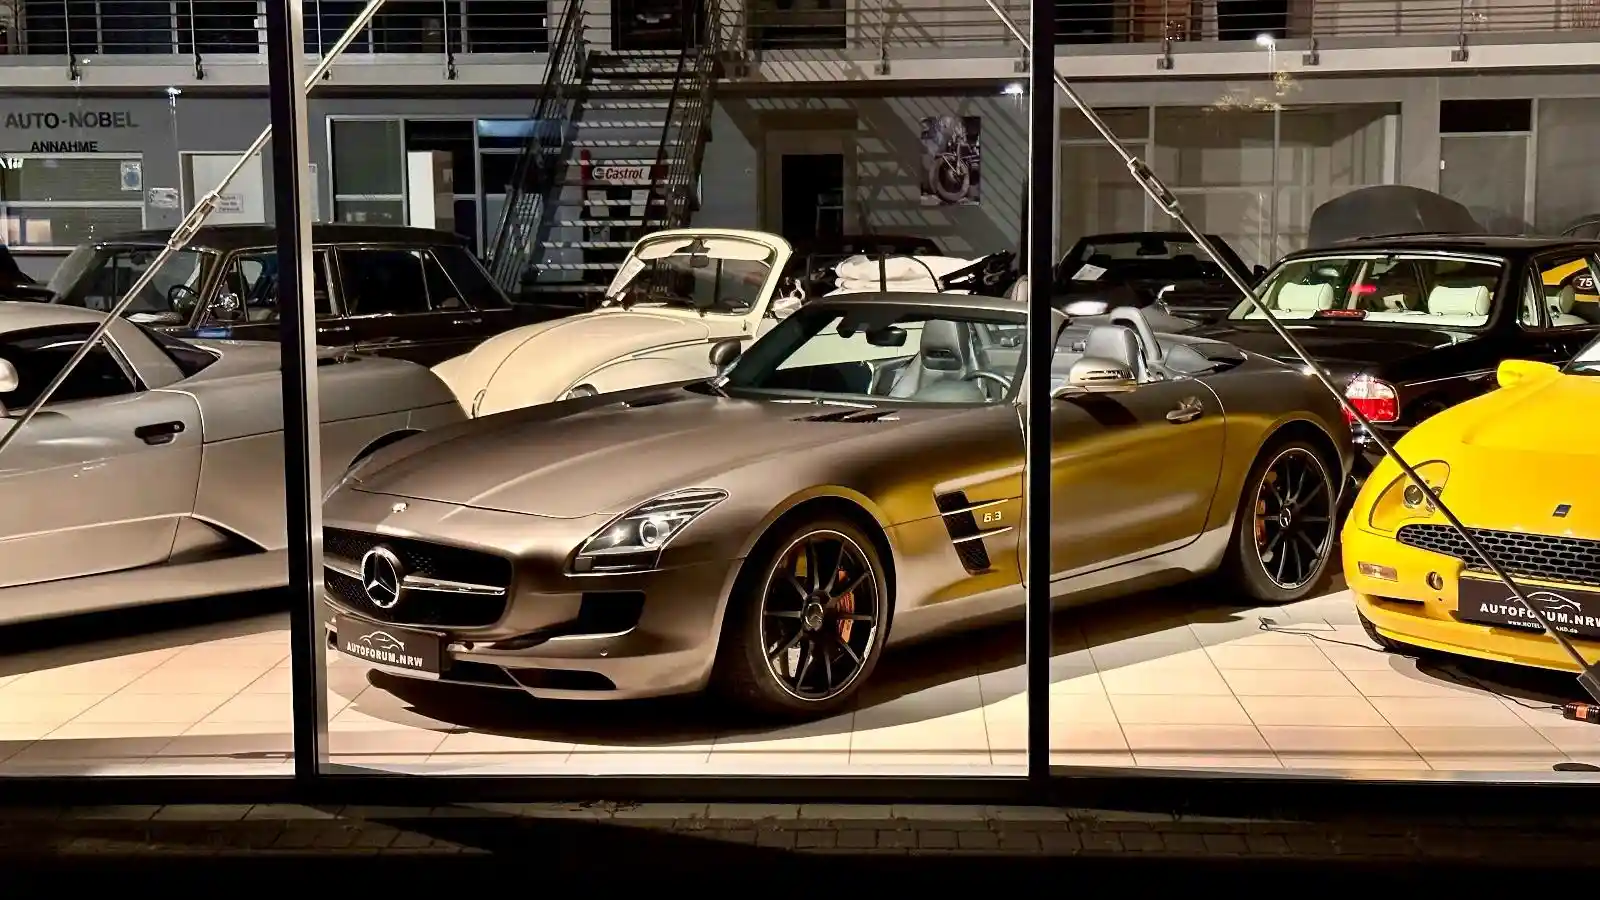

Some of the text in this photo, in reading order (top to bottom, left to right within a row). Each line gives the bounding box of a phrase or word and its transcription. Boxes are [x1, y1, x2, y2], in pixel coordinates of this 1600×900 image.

[31, 141, 99, 152] ANNAHME
[605, 168, 643, 179] Castrol
[1579, 277, 1593, 287] 75
[983, 511, 1002, 523] 6.3
[1480, 603, 1600, 627] AUTOFOUM.NR
[346, 641, 423, 667] AUTOFORUM.NRW
